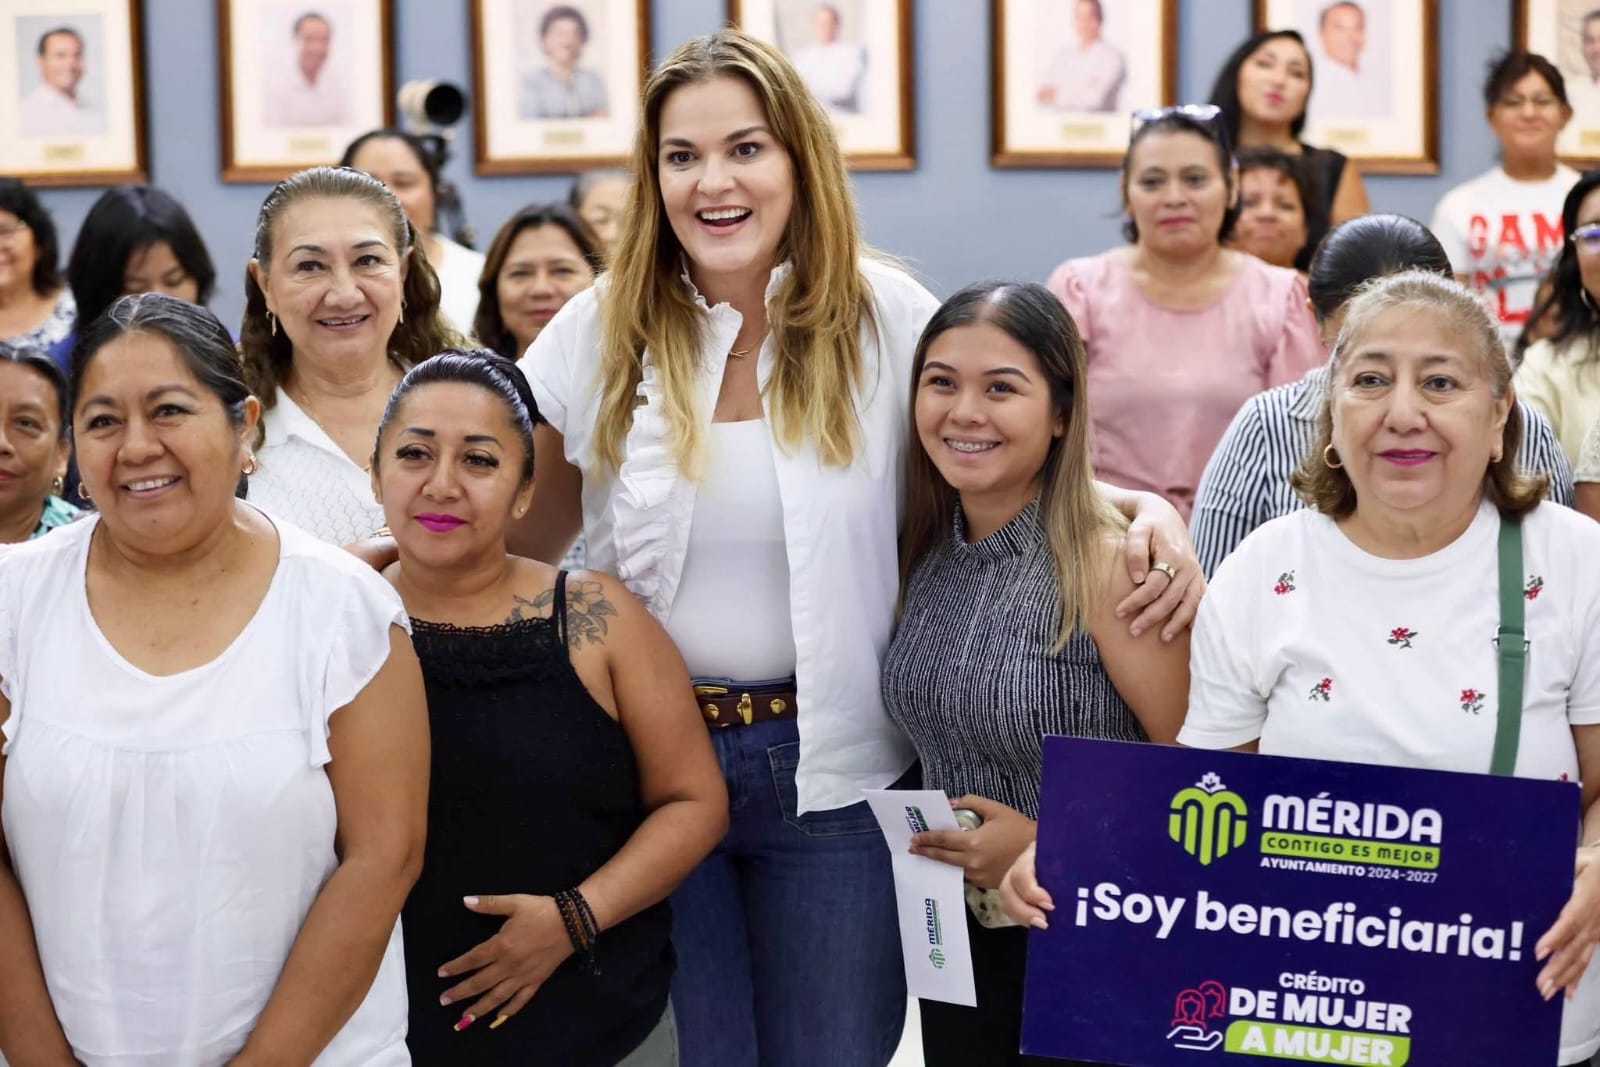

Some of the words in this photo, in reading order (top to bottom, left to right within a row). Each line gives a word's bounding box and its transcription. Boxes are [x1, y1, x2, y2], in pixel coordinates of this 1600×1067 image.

[1262, 792, 1442, 843] MÉRIDA
[1260, 857, 1365, 877] AYUNTAMIENTO
[1367, 867, 1438, 883] 2024-2027
[1267, 837, 1344, 855] CONTIGO
[1351, 845, 1370, 858] ES
[1377, 847, 1434, 863] MEJOR
[1075, 882, 1186, 939] ¡Soy
[1195, 890, 1524, 962] beneficiaria!
[1279, 970, 1365, 995] CRÉDITO
[1229, 987, 1278, 1019] DE
[1282, 993, 1412, 1033] MUJER
[1240, 1025, 1267, 1052] A
[1273, 1028, 1394, 1066] MUJER
